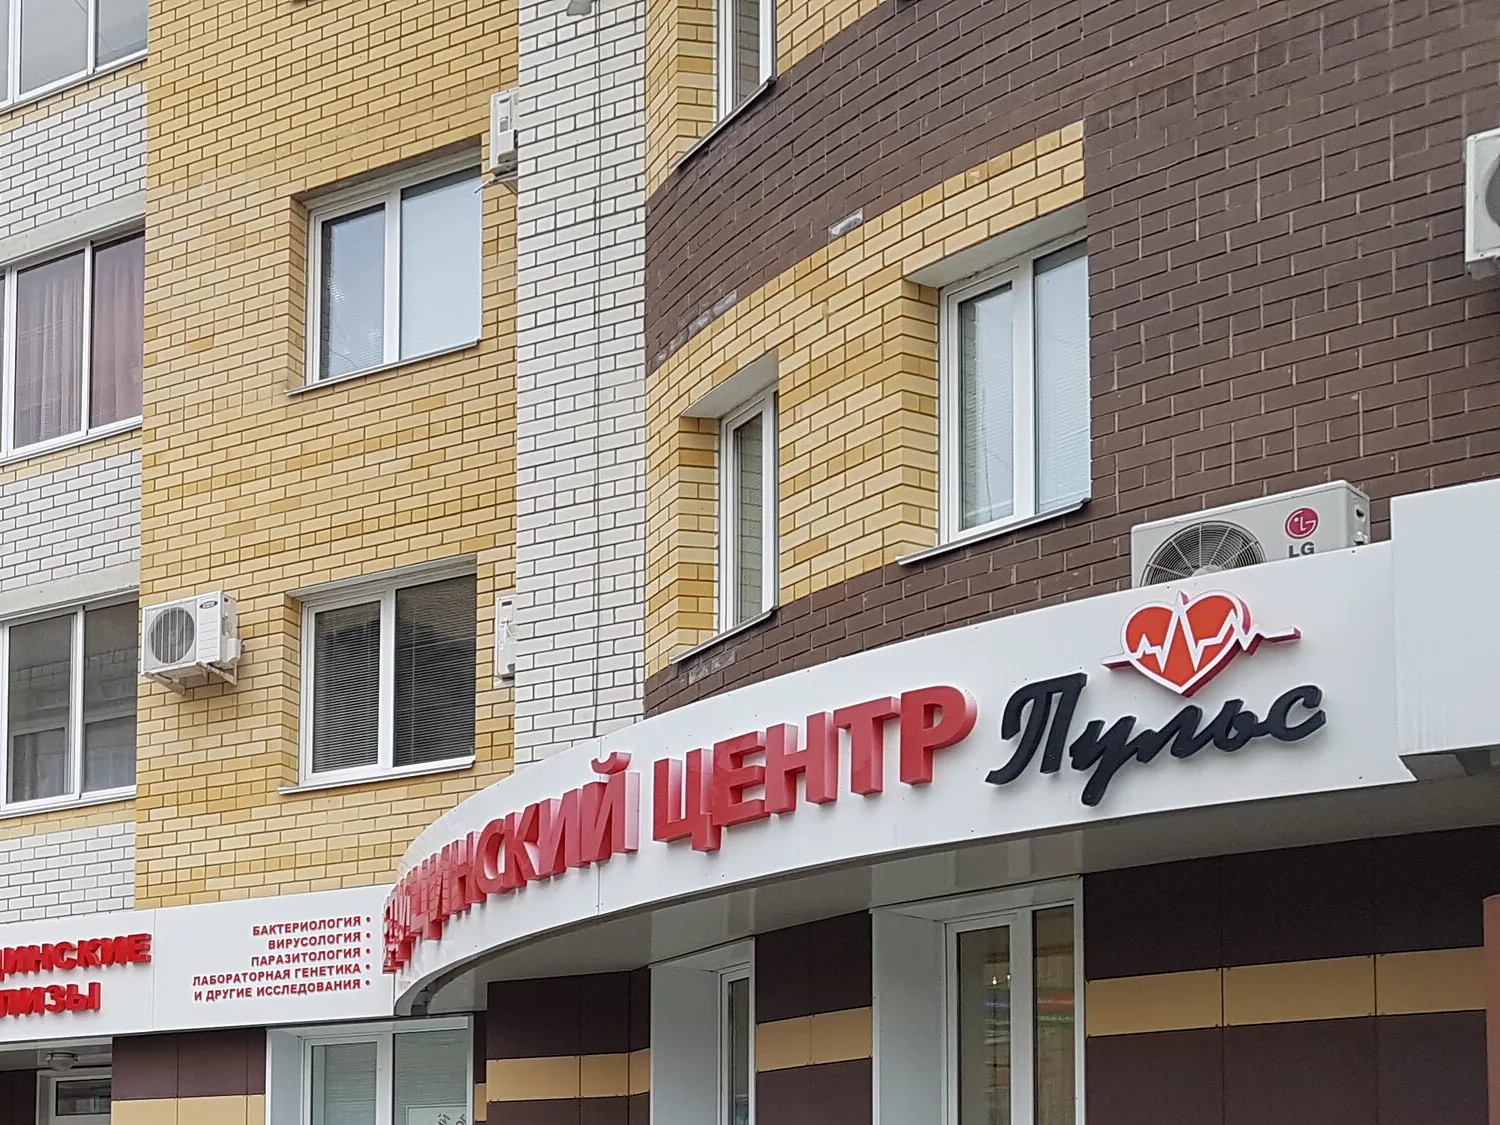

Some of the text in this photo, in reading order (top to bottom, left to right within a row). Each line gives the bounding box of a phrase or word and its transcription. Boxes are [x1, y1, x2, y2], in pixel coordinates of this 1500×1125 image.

[1289, 541, 1315, 558] LG
[652, 686, 978, 853] ЦЕНТР
[985, 672, 1327, 807] Пульс
[253, 916, 361, 936] БАКТЕРИОЛОГИЯ
[268, 932, 361, 950] ВИРУСОЛОГИЯ
[251, 947, 361, 967] ПАРАЗИТОЛОГИЯ
[192, 963, 361, 986] ЛАБОРАТОРНАЯ ГЕНЕТИКА
[194, 979, 361, 1002] И ДРУГИЕ ИССЛЕДОВАНИЯ
